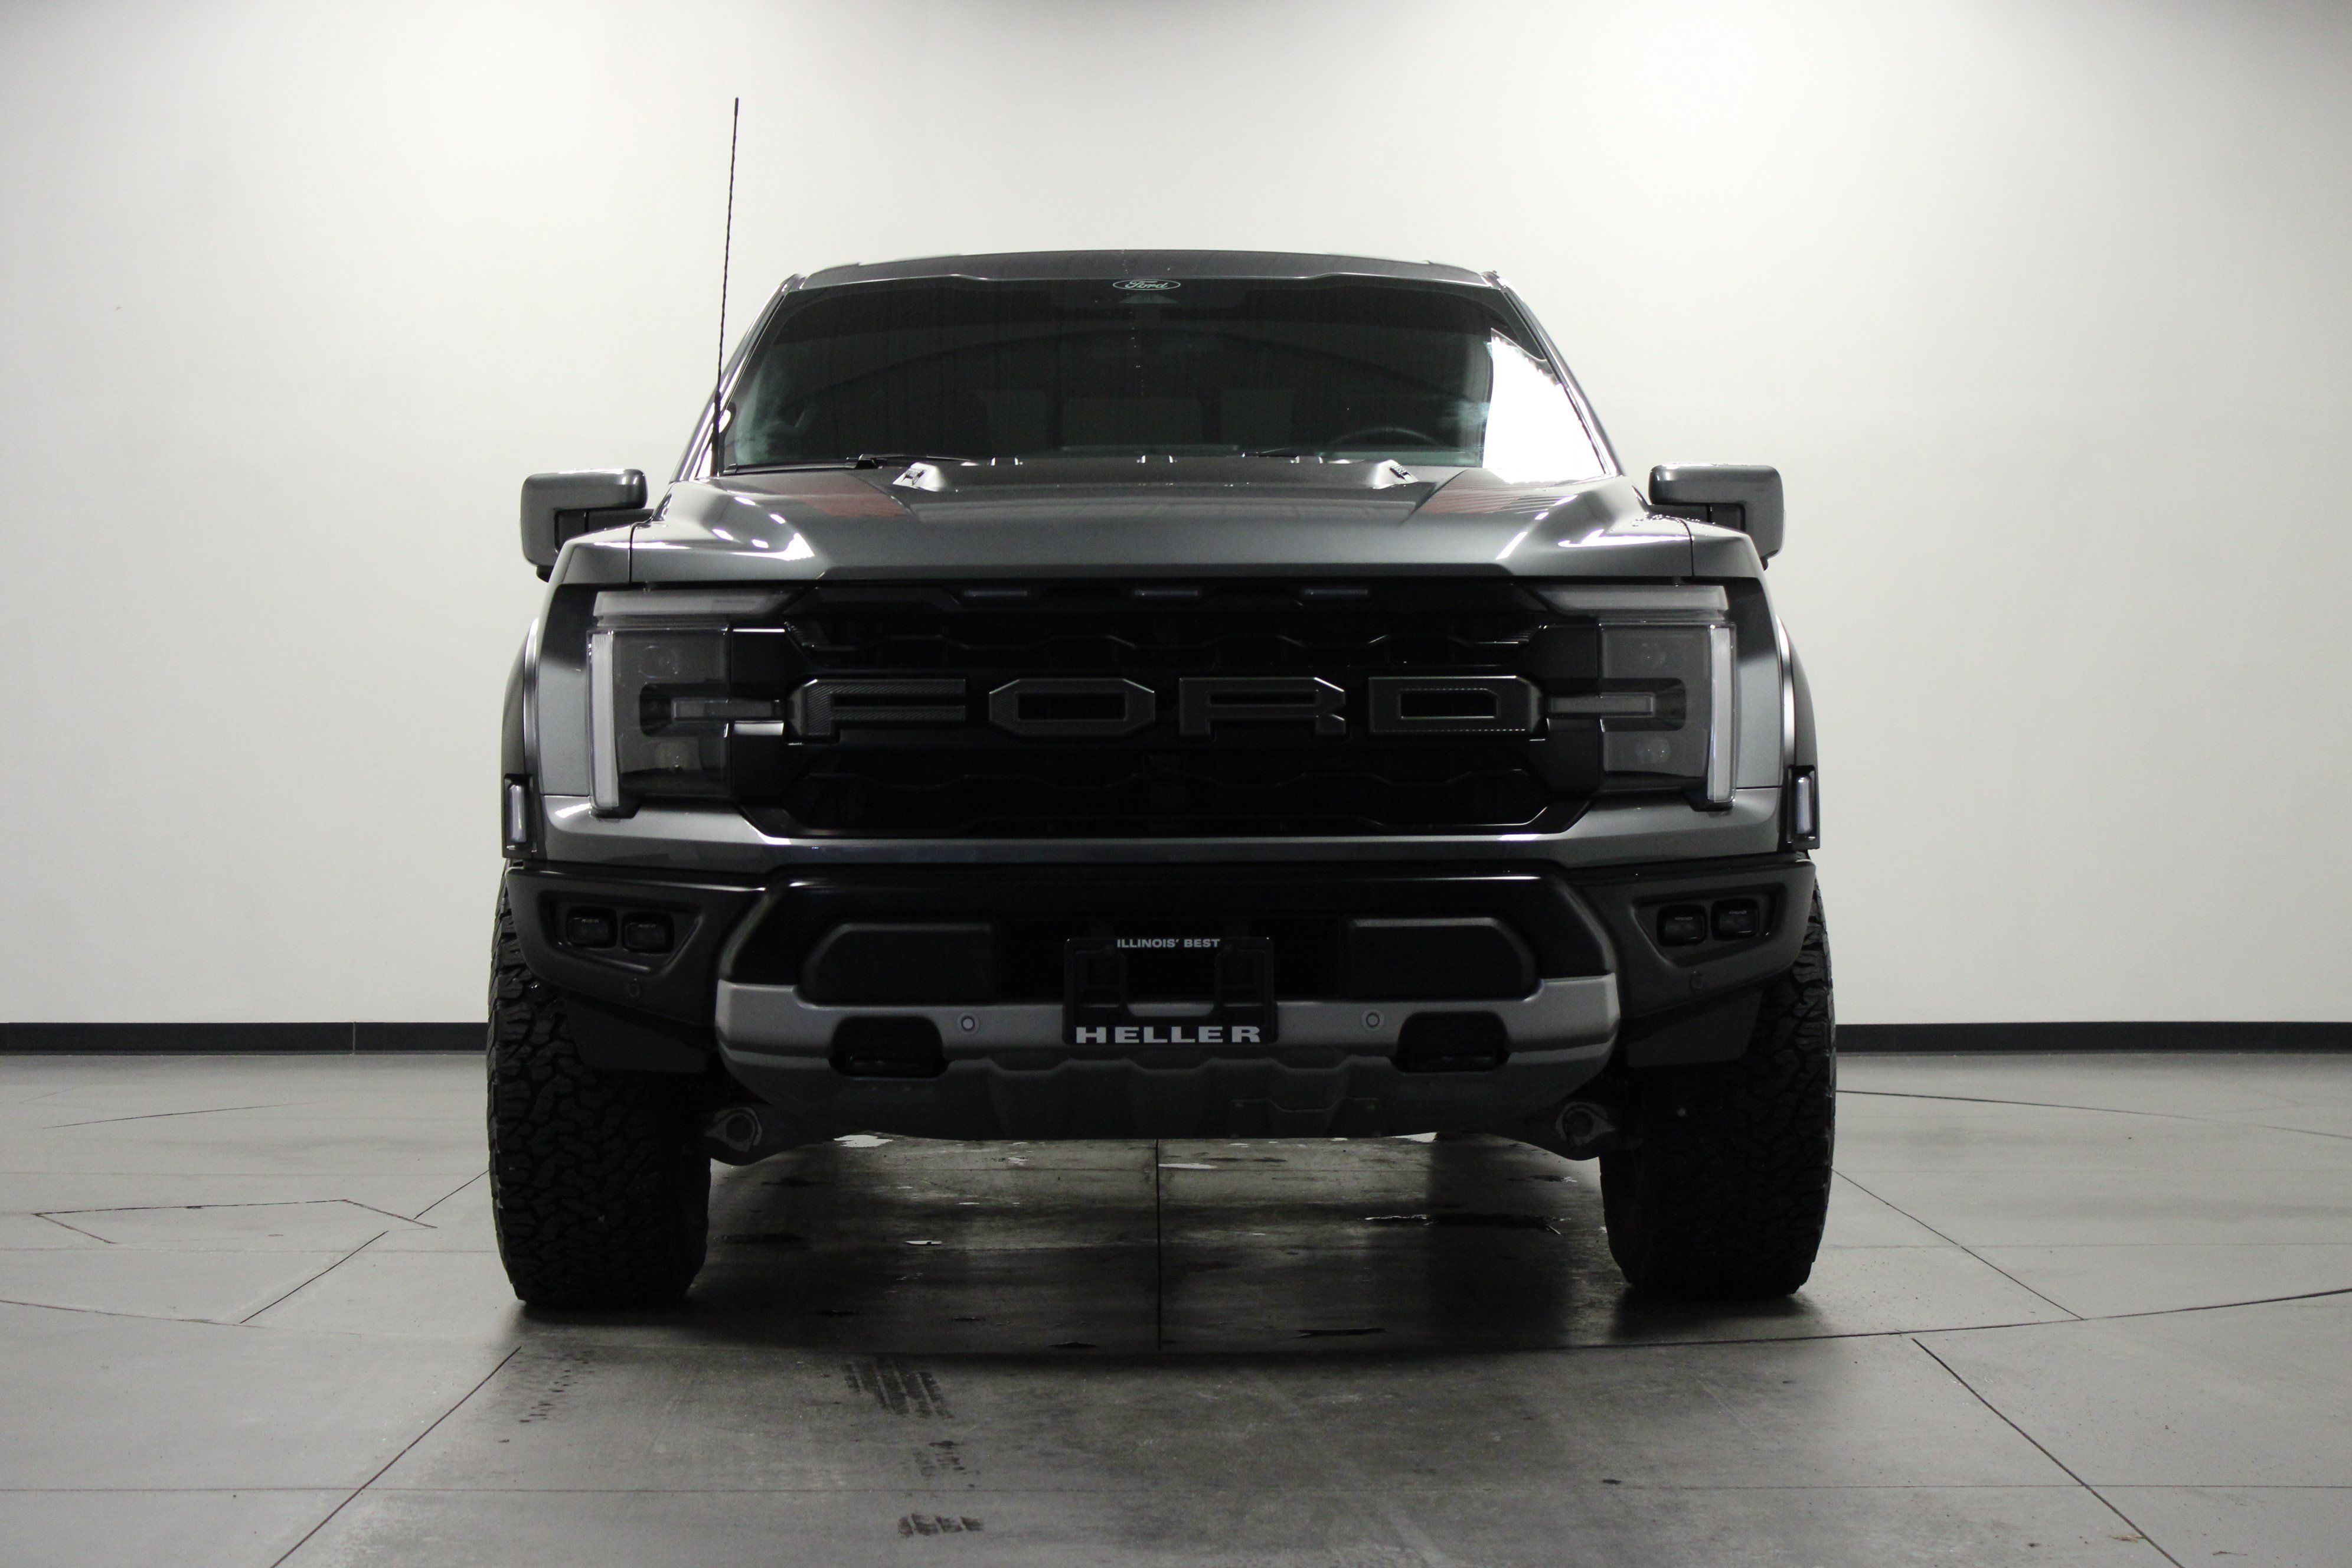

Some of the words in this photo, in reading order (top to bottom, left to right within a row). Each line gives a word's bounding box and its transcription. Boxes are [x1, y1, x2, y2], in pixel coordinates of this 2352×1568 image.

[788, 677, 1543, 736] FORD
[1184, 939, 1220, 948] BEST
[1076, 1026, 1261, 1044] HELLER
